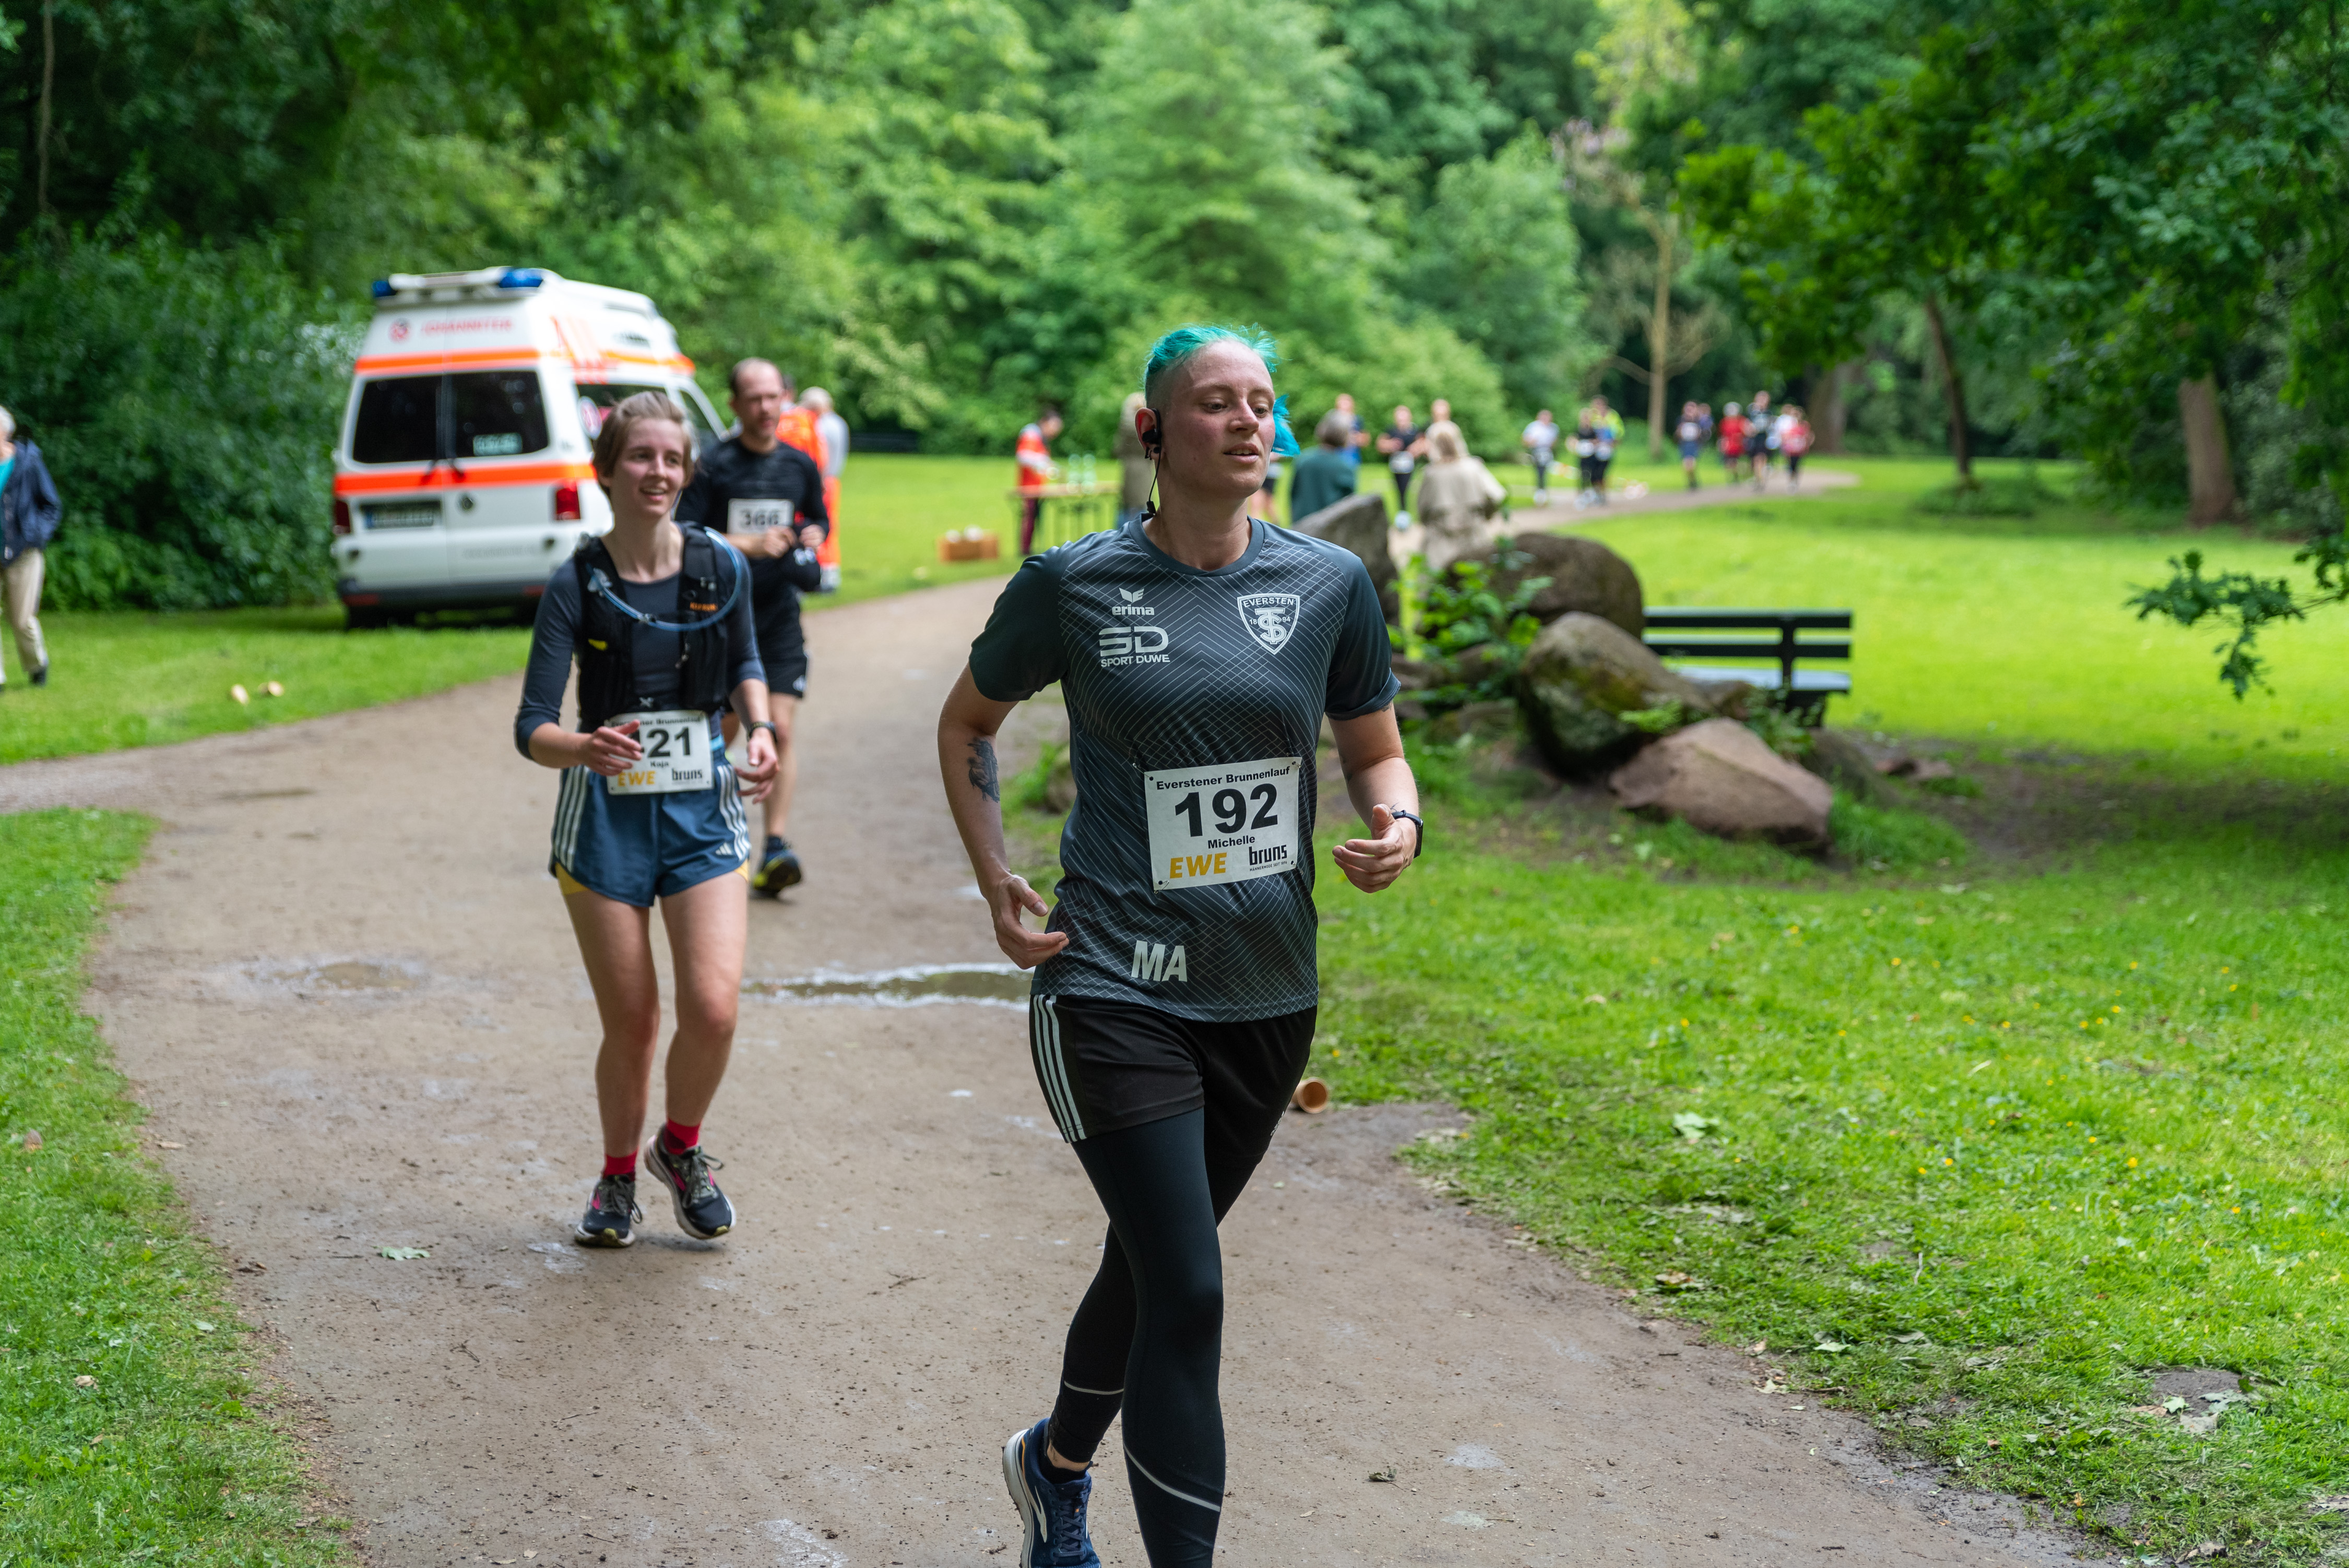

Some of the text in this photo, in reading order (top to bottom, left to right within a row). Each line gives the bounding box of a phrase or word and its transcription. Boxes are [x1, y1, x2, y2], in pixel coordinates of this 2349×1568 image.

[740, 508, 780, 530] 366
[1112, 604, 1155, 615] erima
[1243, 597, 1294, 608] EVERSTEN
[1100, 654, 1171, 668] SPORT DUWE
[650, 758, 669, 768] Kaja
[617, 768, 703, 787] EWE bruns
[1156, 766, 1290, 790] Everstener Brunnenlauf
[1174, 783, 1278, 838] 192
[1207, 835, 1256, 849] Michelle
[1169, 845, 1287, 879] EWE bruns
[1131, 940, 1188, 982] MA
